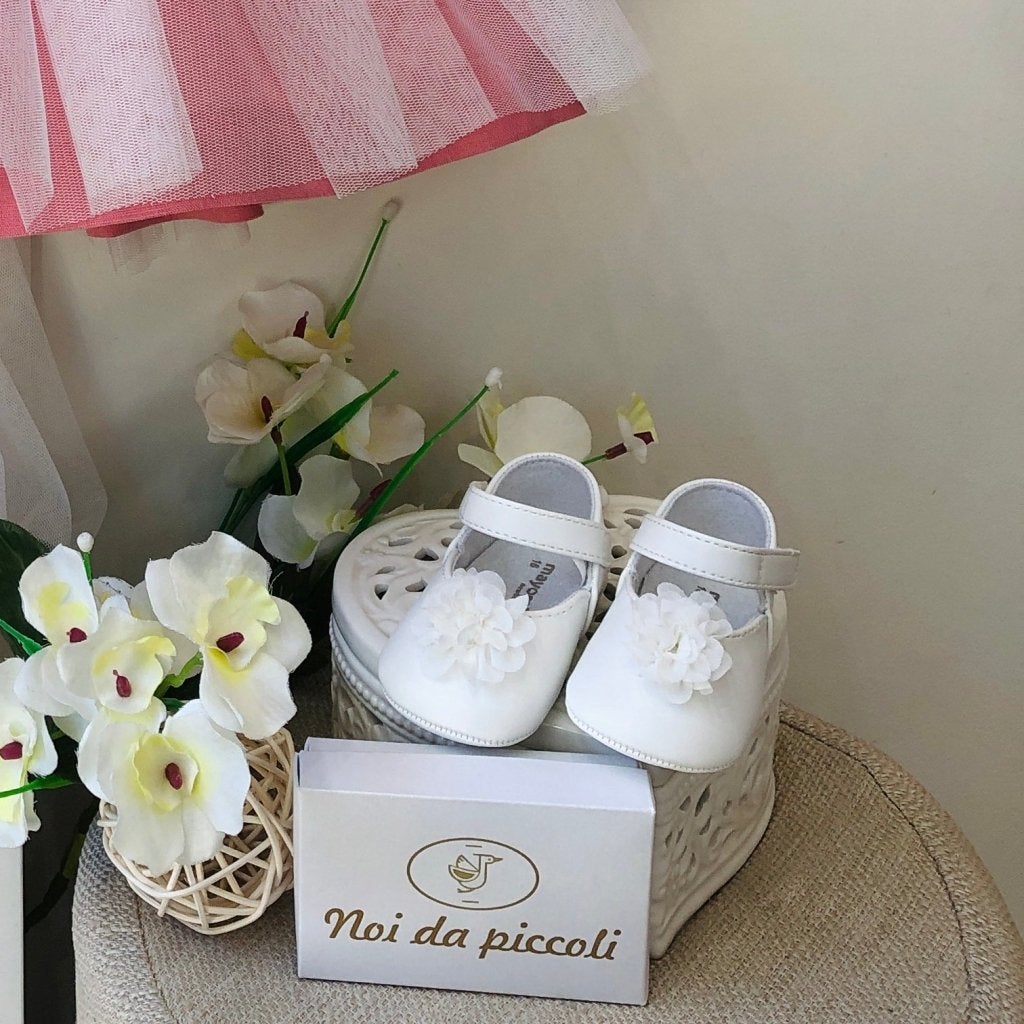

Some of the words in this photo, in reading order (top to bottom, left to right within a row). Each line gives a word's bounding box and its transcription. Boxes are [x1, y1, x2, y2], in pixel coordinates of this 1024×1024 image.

[526, 563, 556, 610] mayo
[323, 907, 404, 943] Noi
[409, 915, 470, 949] da
[478, 921, 623, 961] piccoli
